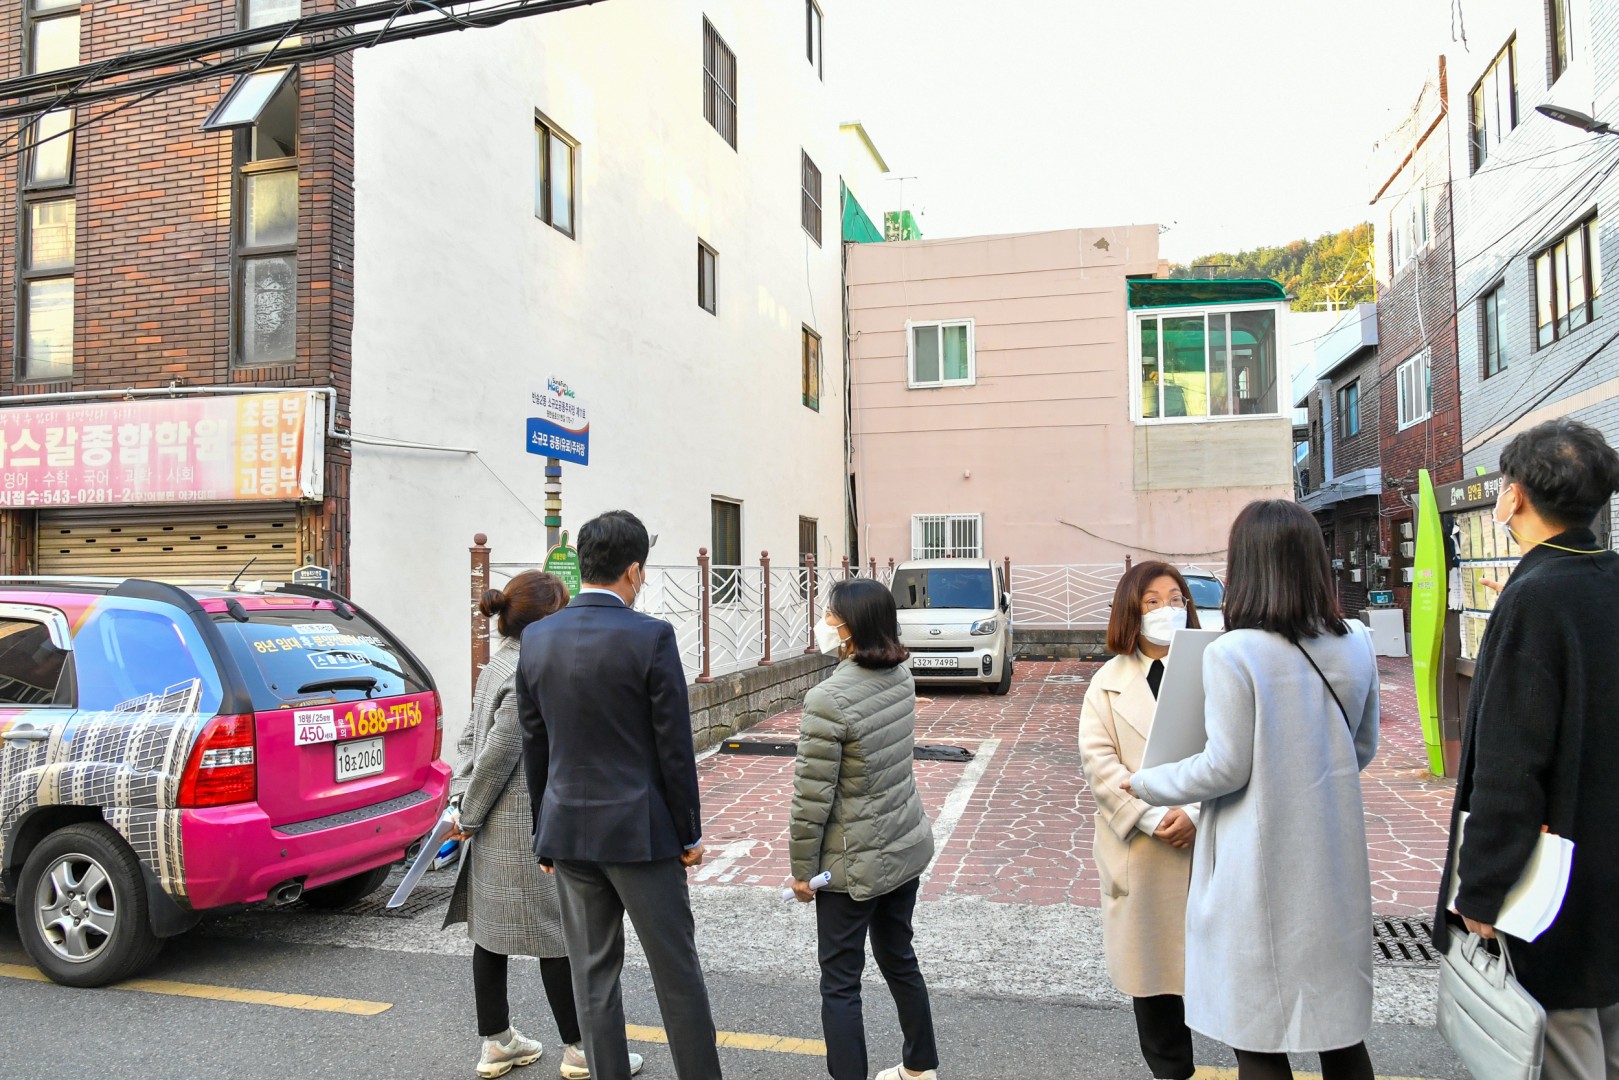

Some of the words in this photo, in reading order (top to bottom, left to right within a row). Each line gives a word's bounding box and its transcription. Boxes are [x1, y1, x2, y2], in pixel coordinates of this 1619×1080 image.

[242, 397, 299, 428] 초등부
[240, 432, 298, 463] 중등부
[532, 430, 548, 446] 소규모
[4, 471, 29, 489] 영어
[43, 470, 69, 488] 수학
[83, 469, 109, 487] 국어
[124, 466, 152, 485] 과학
[166, 465, 194, 484] 사회
[240, 465, 297, 496] 고등부
[1467, 483, 1482, 501] 담안골
[253, 640, 278, 653] 8년
[276, 637, 302, 651] 임대
[299, 635, 315, 649] 후
[345, 701, 422, 737] 1688-7756
[338, 748, 382, 773] 18조2060
